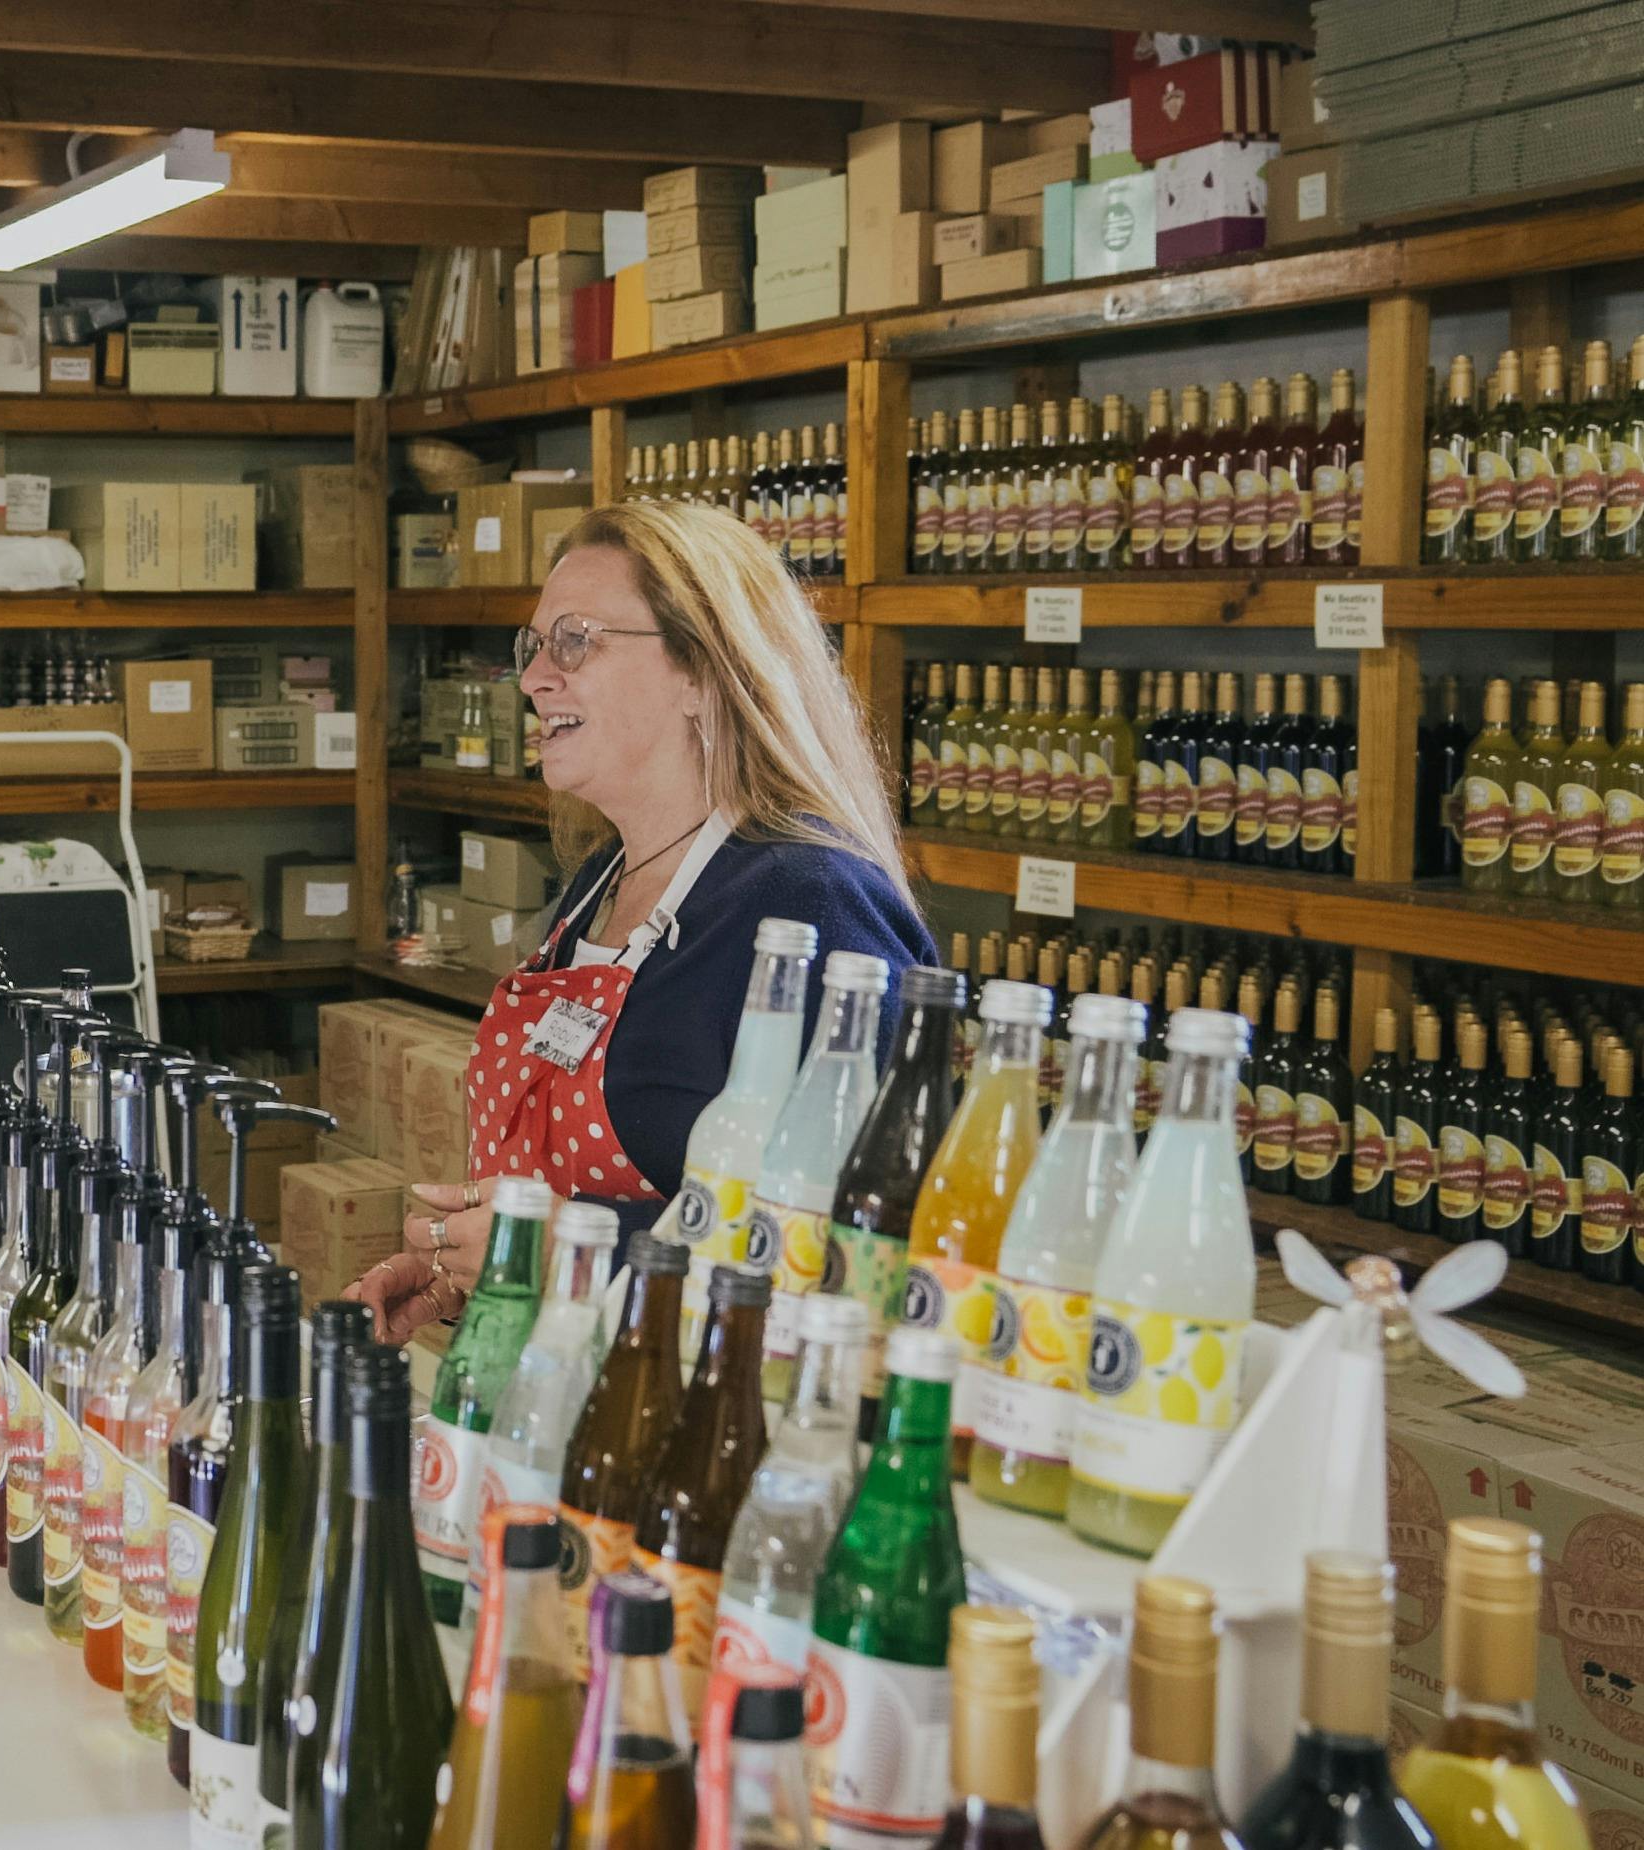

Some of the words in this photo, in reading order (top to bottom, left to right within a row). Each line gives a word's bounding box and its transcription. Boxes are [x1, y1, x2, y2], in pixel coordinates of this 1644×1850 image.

[1569, 1465, 1644, 1498] HANDL
[1567, 1606, 1644, 1641] CORD
[1389, 1659, 1445, 1694] BOTTLE
[1546, 1723, 1565, 1744] 12
[1567, 1734, 1579, 1750] x
[1582, 1737, 1629, 1770] 750ml
